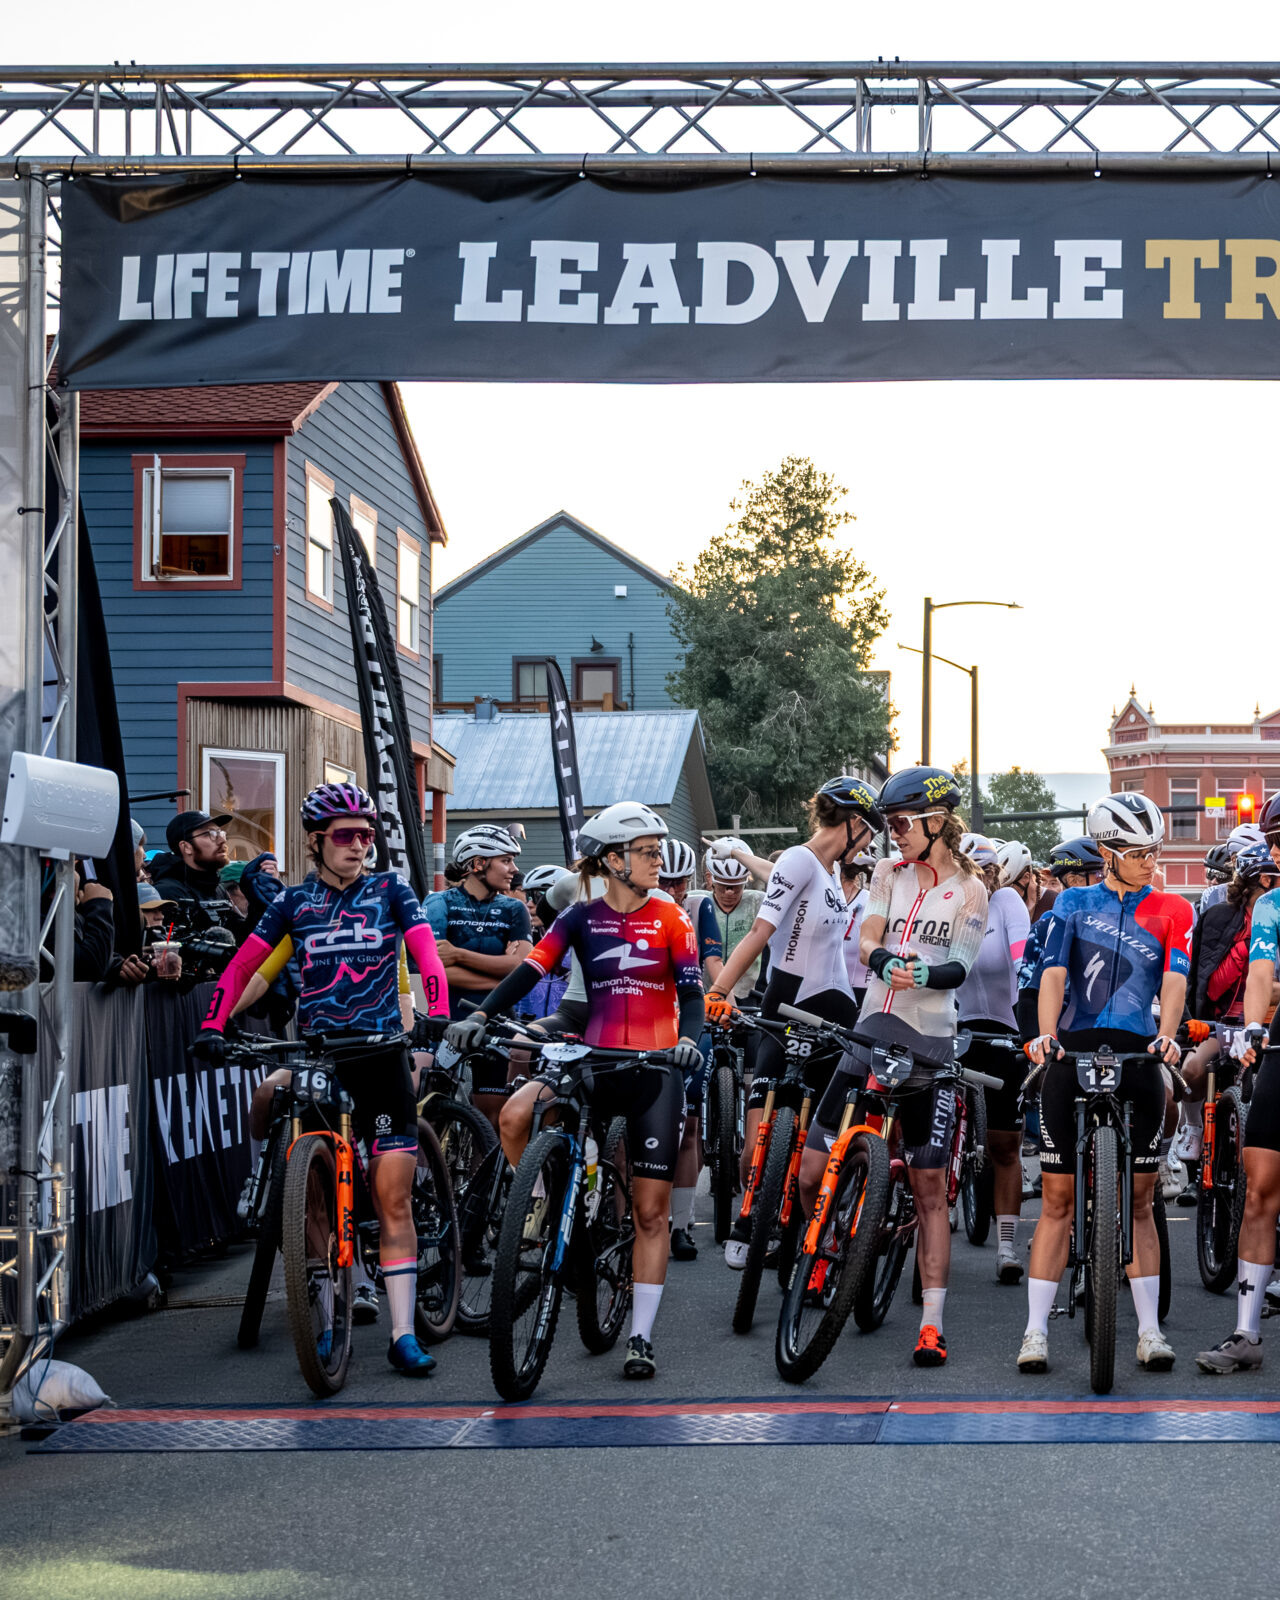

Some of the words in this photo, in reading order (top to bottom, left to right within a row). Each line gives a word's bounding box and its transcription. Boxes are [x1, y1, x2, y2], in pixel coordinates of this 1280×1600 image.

[454, 238, 1124, 325] LEADVILLE
[785, 900, 808, 962] THOMPSON
[1083, 915, 1160, 961] SPECIALIZED
[591, 978, 623, 989] Human
[623, 976, 665, 991] Powered
[611, 986, 644, 996] Health
[786, 1039, 812, 1057] 28
[885, 1058, 898, 1073] 7
[298, 1071, 327, 1090] 16
[1085, 1069, 1116, 1086] 12
[930, 1089, 952, 1148] FACTOR
